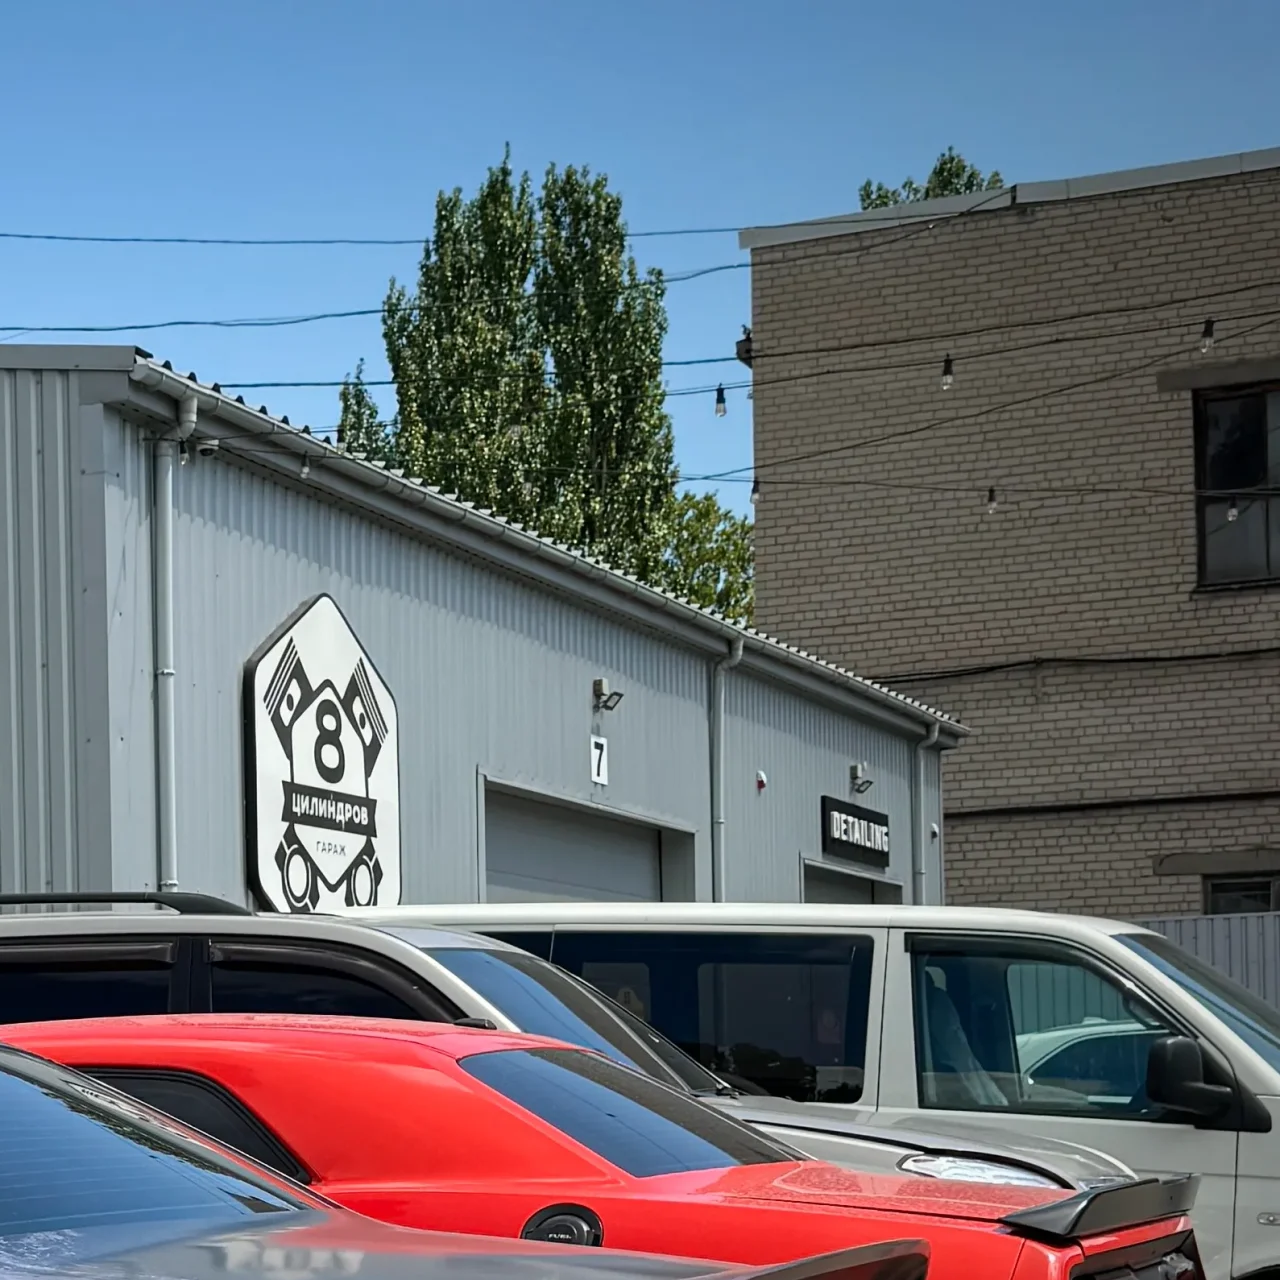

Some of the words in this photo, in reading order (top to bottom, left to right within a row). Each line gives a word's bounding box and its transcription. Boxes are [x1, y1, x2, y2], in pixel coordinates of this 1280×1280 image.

[314, 698, 345, 784] 8
[594, 740, 605, 778] 7
[292, 792, 369, 830] ЦИЛИНДРОВ
[316, 841, 346, 857] ГАРАЖ
[830, 811, 888, 852] DETAILING
